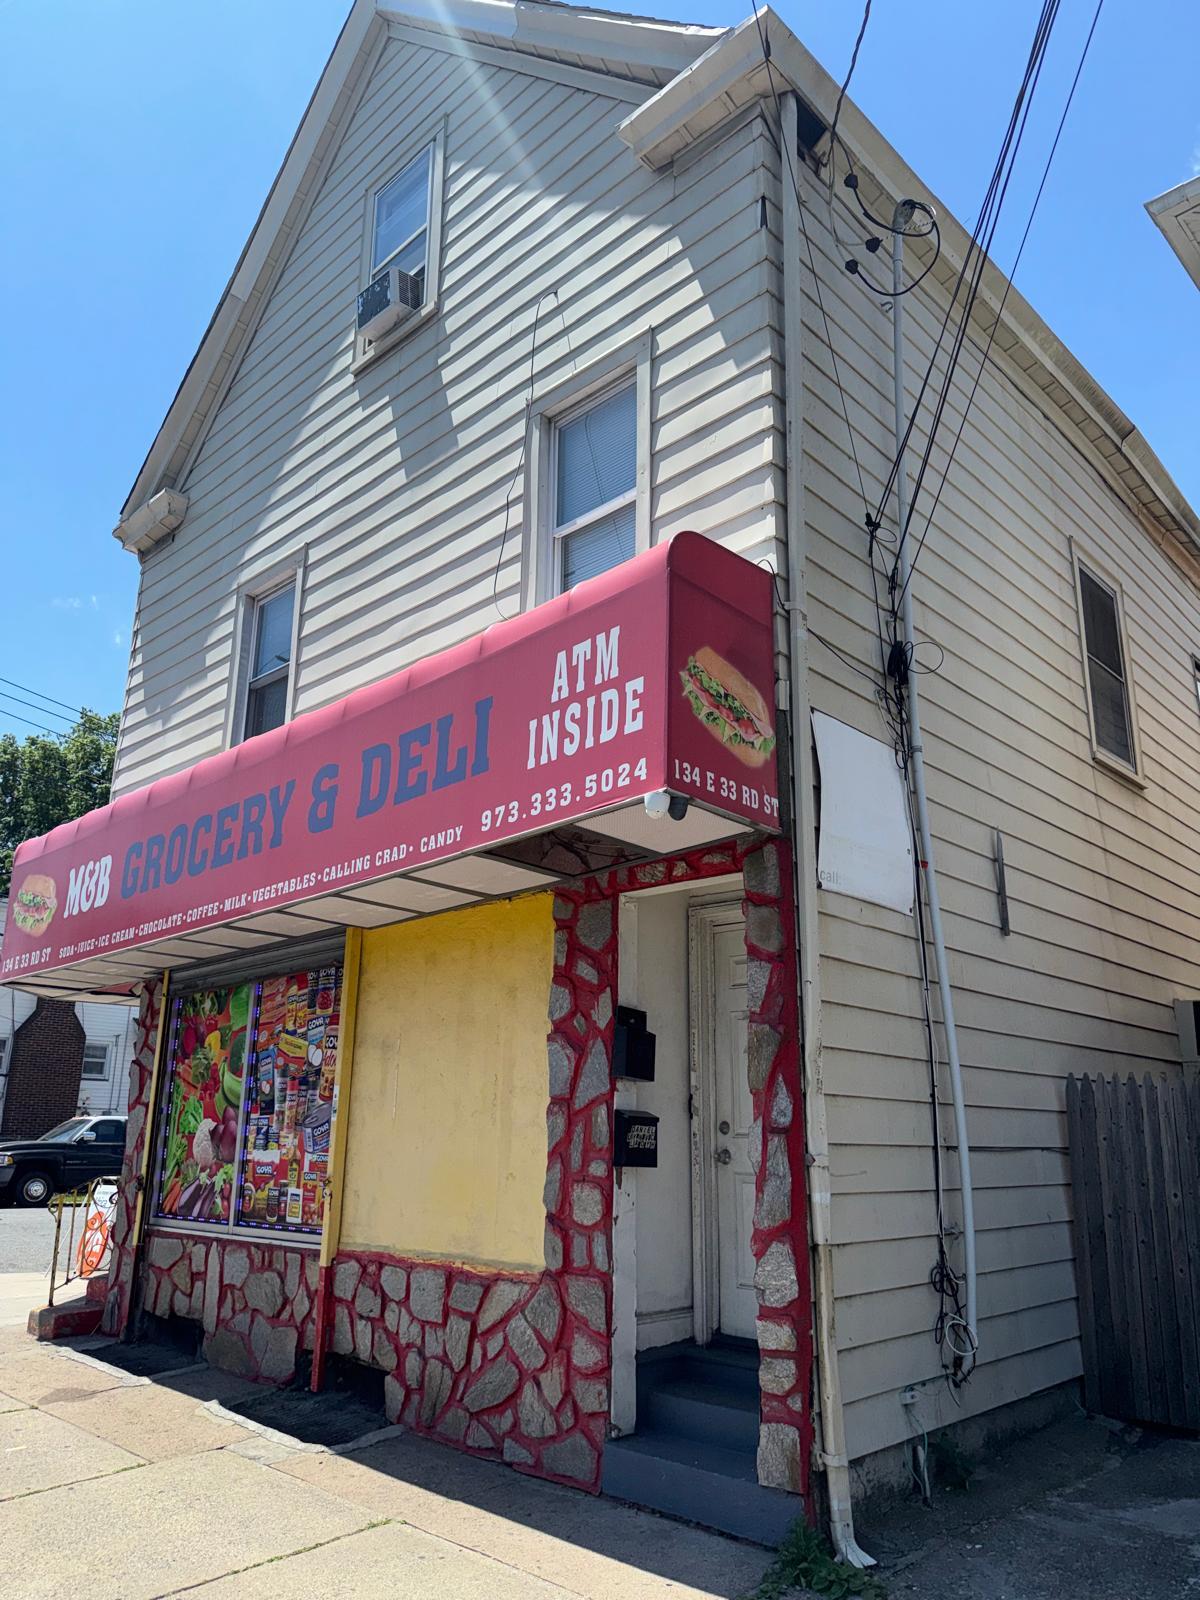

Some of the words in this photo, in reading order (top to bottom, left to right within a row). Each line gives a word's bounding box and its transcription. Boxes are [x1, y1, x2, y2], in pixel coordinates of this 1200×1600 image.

[551, 625, 620, 702] ATM
[527, 676, 644, 770] INSIDE
[63, 854, 113, 918] M&B
[121, 779, 296, 899] GROCERY
[308, 763, 339, 834] &
[356, 696, 493, 818] DELI
[481, 757, 648, 832] 973.333.5024
[675, 759, 700, 787] 134
[706, 771, 715, 792] E
[720, 776, 737, 800] 33
[742, 784, 759, 809] RD
[763, 794, 779, 817] ST
[111, 927, 135, 944] CREAM
[420, 825, 464, 853] CANDY
[41, 947, 52, 963] ST
[313, 1123, 329, 1136] GOYA
[256, 1164, 273, 1174] GOYA
